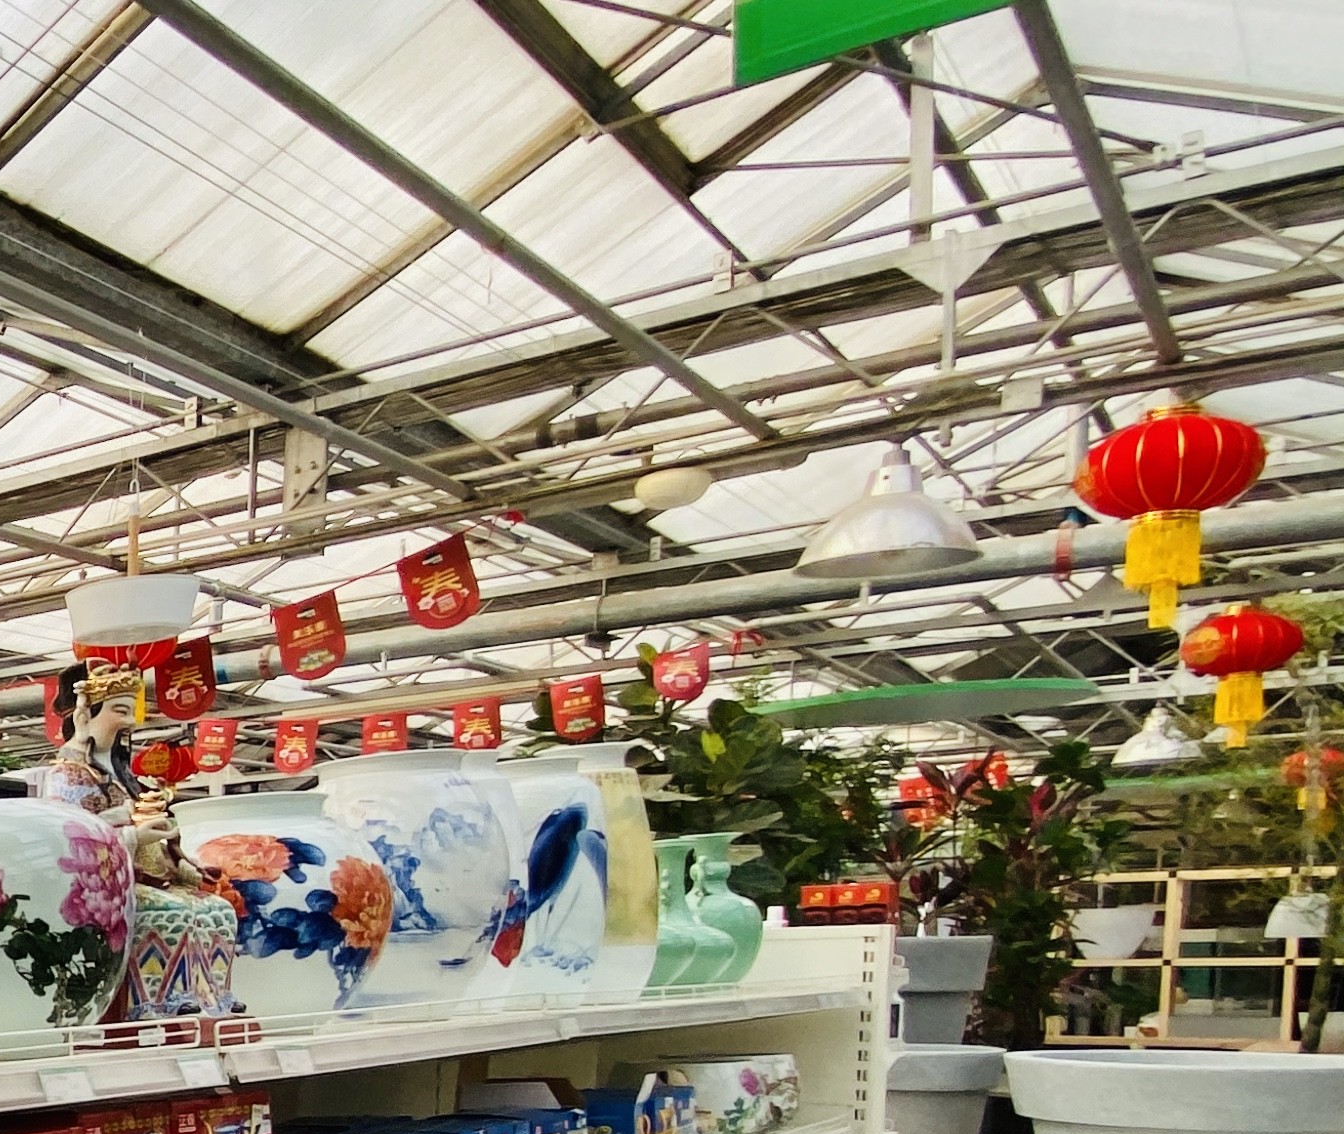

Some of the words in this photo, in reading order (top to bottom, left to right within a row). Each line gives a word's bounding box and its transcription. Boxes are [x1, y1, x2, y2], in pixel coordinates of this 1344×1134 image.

[419, 568, 462, 598] 春
[169, 665, 203, 690] 春
[463, 718, 493, 737] 春
